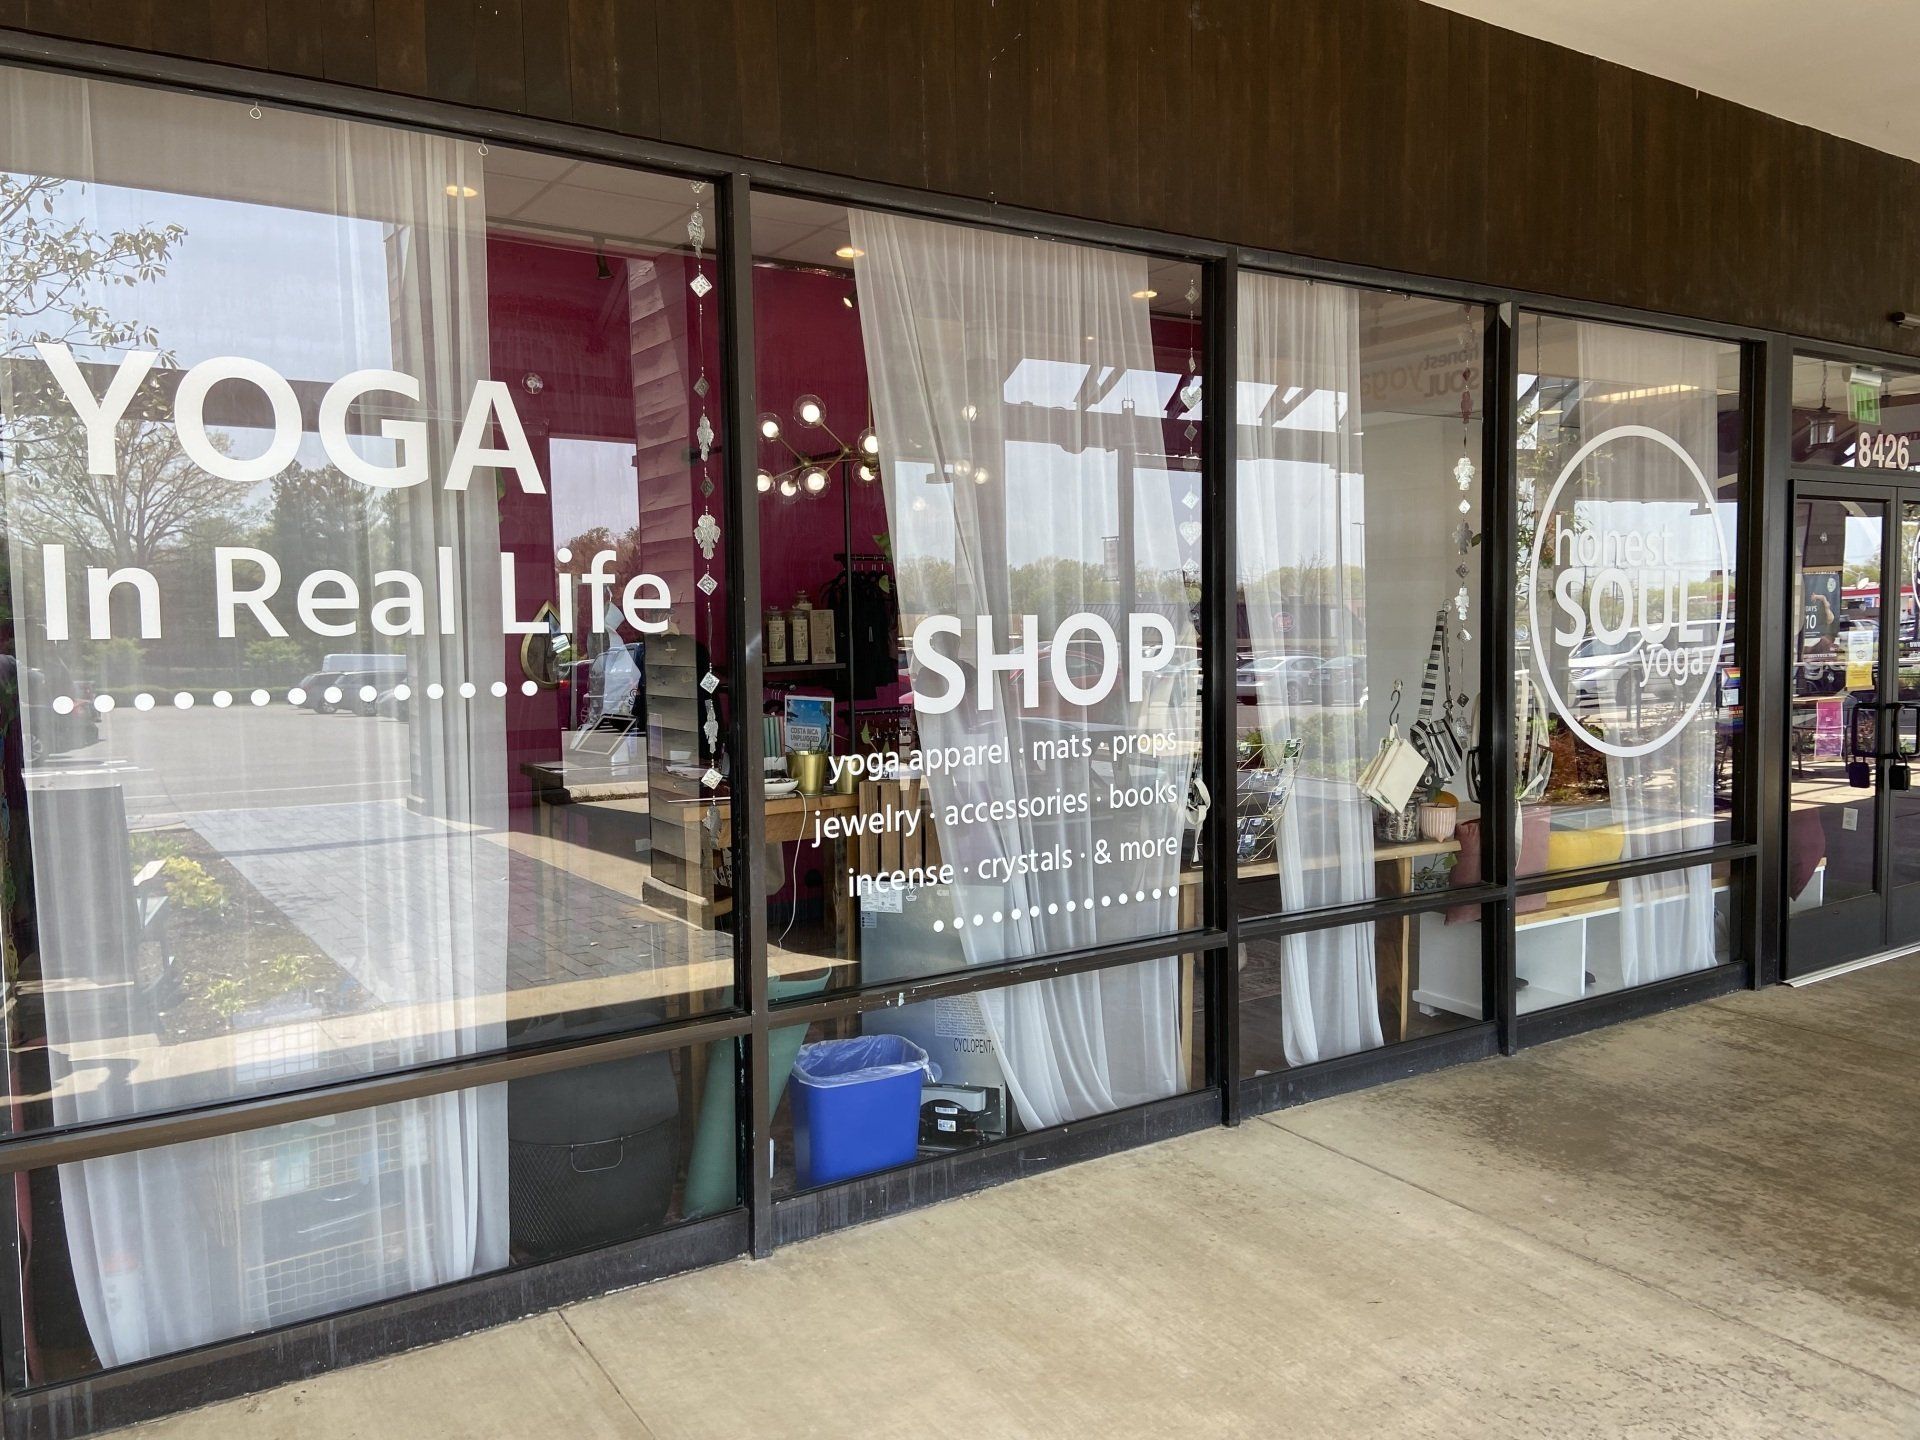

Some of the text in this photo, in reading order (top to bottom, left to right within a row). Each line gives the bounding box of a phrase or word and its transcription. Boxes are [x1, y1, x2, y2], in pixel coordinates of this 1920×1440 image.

[35, 342, 547, 495] YOGA
[1858, 431, 1910, 471] 8426
[1555, 514, 1675, 568] honest
[42, 543, 673, 641] In Real Life
[1554, 567, 1704, 648] SOUL
[1806, 614, 1817, 629] 10
[912, 612, 1176, 715] SHOP
[1639, 646, 1704, 688] yoga
[828, 729, 1177, 784] yoga apparel mats props
[812, 779, 1178, 848] jewelry accessories books
[848, 861, 955, 898] incense
[978, 841, 1073, 884] crystals
[1093, 838, 1112, 865] &
[1120, 835, 1178, 862] more
